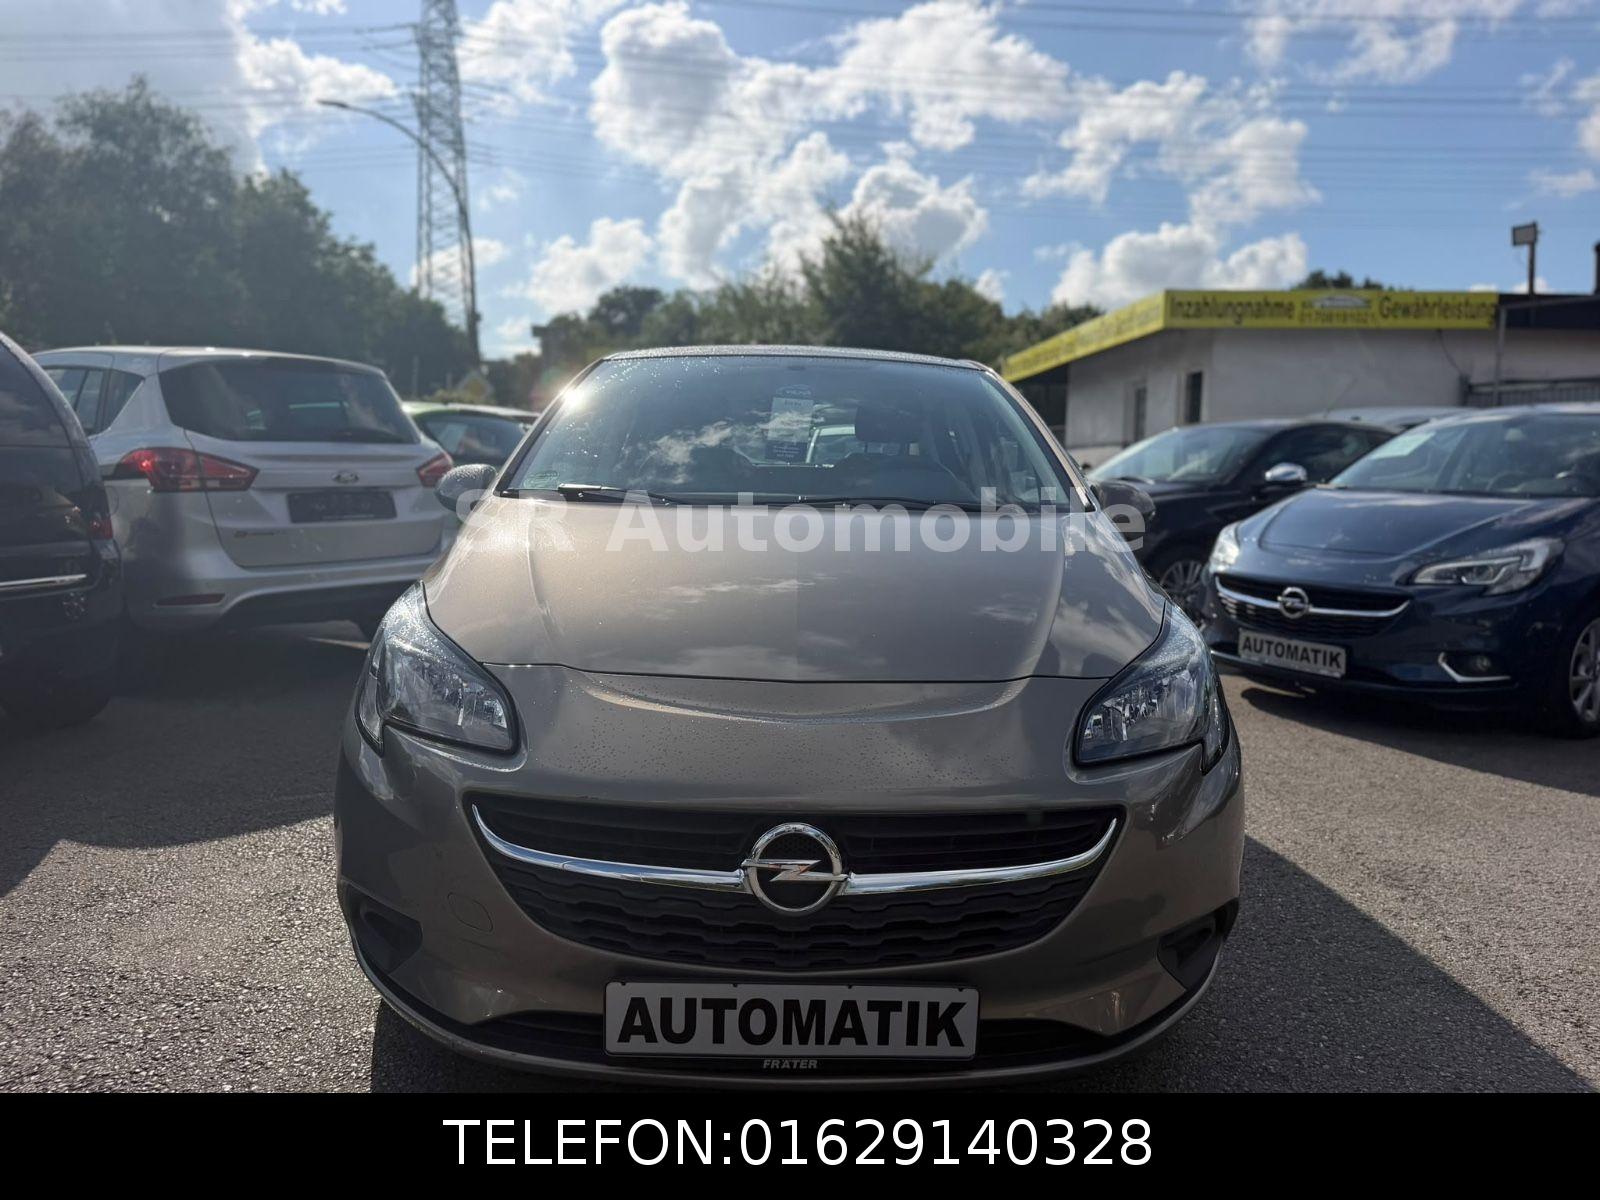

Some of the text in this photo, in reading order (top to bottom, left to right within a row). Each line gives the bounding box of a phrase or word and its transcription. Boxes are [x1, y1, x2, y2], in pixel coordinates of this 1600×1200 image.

[1170, 294, 1296, 325] Inzahlungnahme
[1242, 637, 1342, 669] AUTOMATIK
[617, 996, 967, 1048] AUTOMATIK
